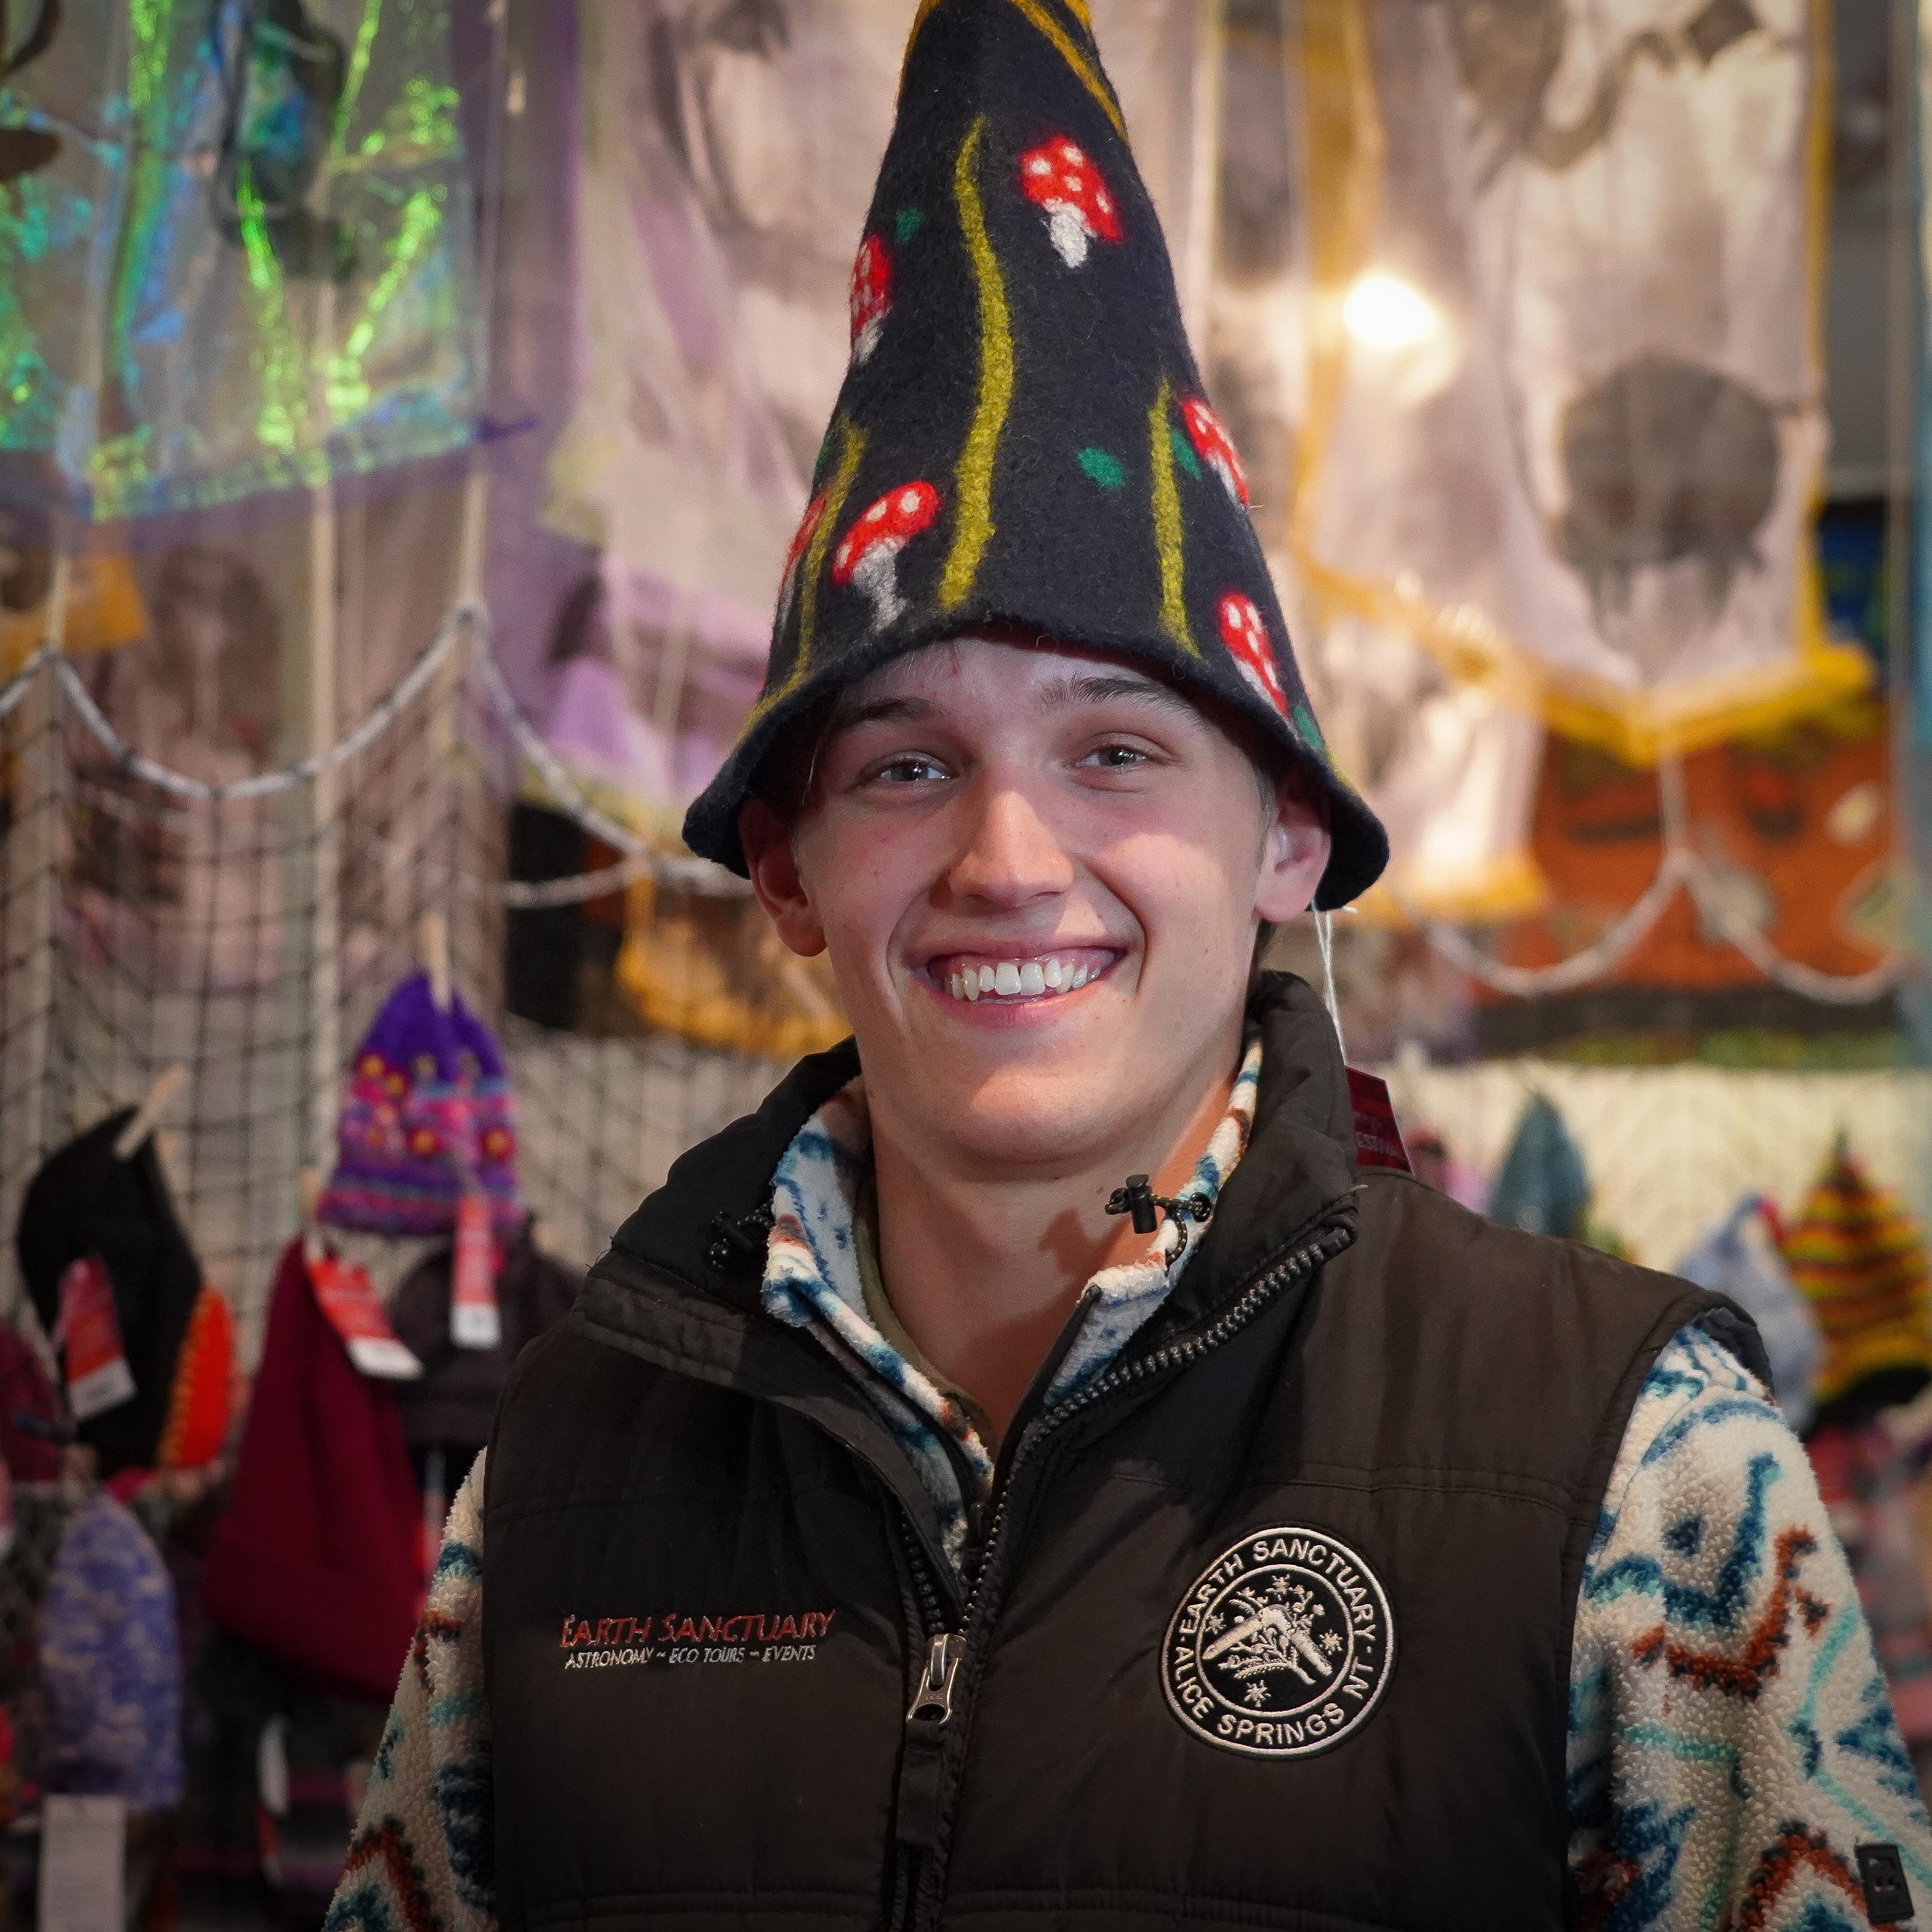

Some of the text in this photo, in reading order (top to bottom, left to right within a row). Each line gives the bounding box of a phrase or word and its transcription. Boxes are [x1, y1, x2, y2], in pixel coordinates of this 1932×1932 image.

[1178, 1538, 1377, 1641] EARTH SANCTUARY
[560, 1609, 836, 1648] EARTH SANCTUARY
[564, 1647, 654, 1669] ASTRONOMY
[669, 1647, 699, 1663] ECO
[703, 1646, 745, 1663] TOURS
[761, 1644, 816, 1662] EVENTS
[1174, 1646, 1374, 1745] ALICE SPRINGS NT
